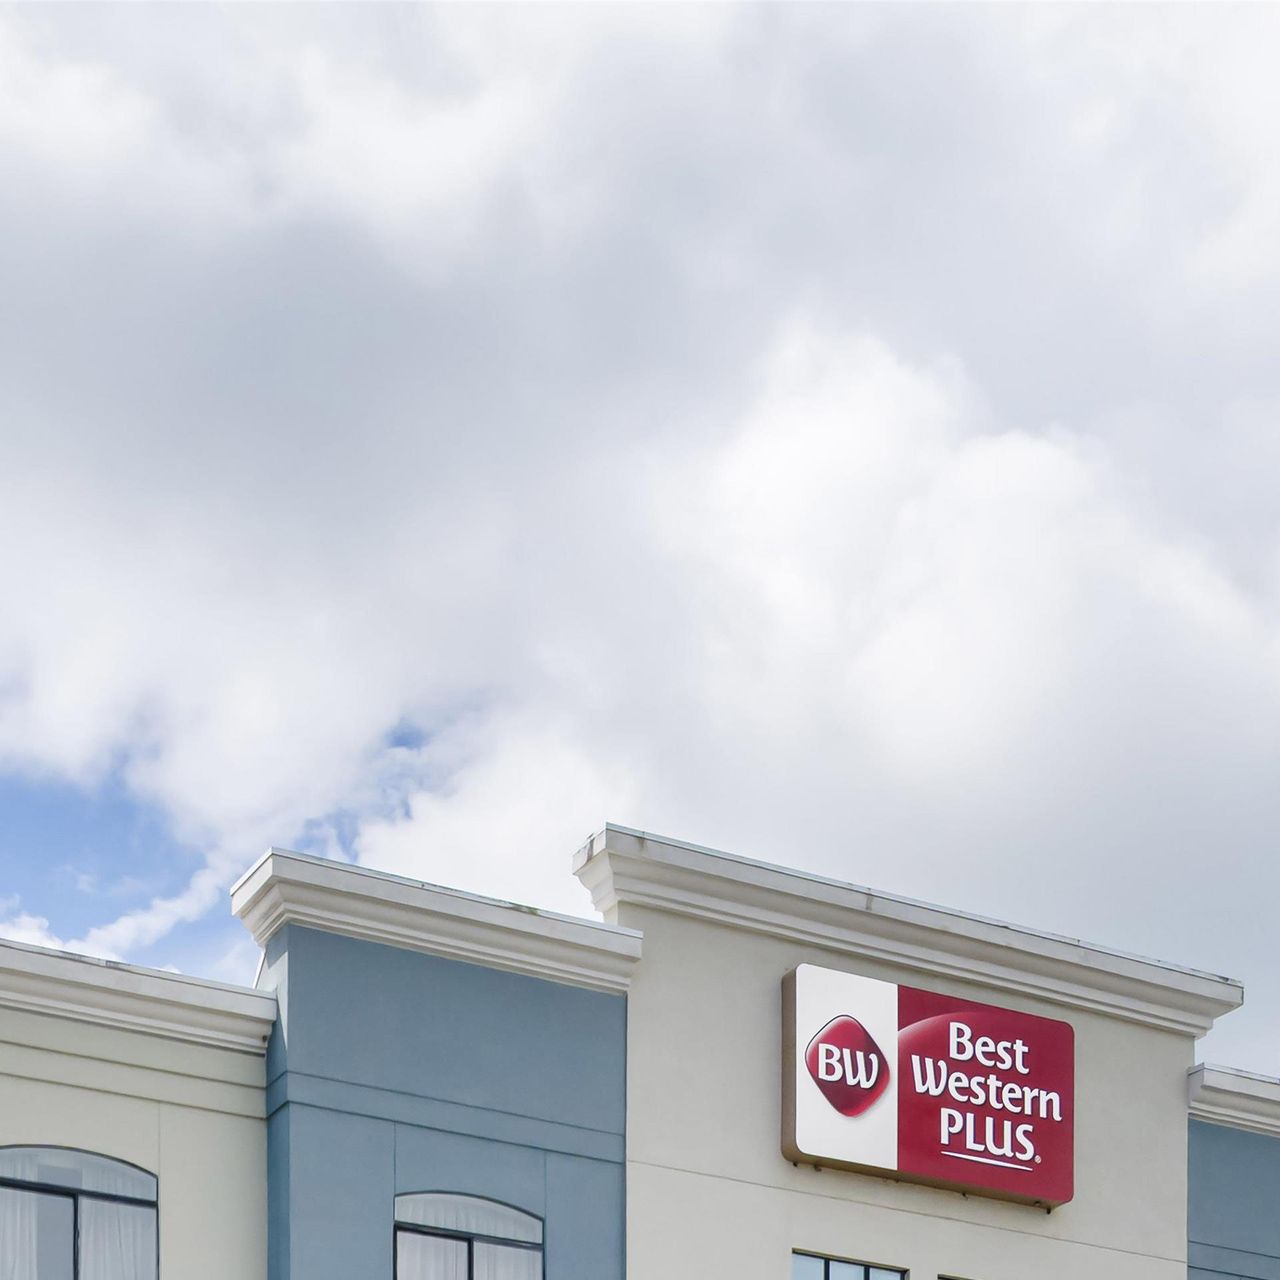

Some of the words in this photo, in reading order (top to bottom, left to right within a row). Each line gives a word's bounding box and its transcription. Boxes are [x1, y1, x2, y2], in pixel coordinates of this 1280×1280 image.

[817, 1042, 879, 1089] BW
[949, 1021, 1030, 1074] Best
[911, 1054, 1062, 1121] Western
